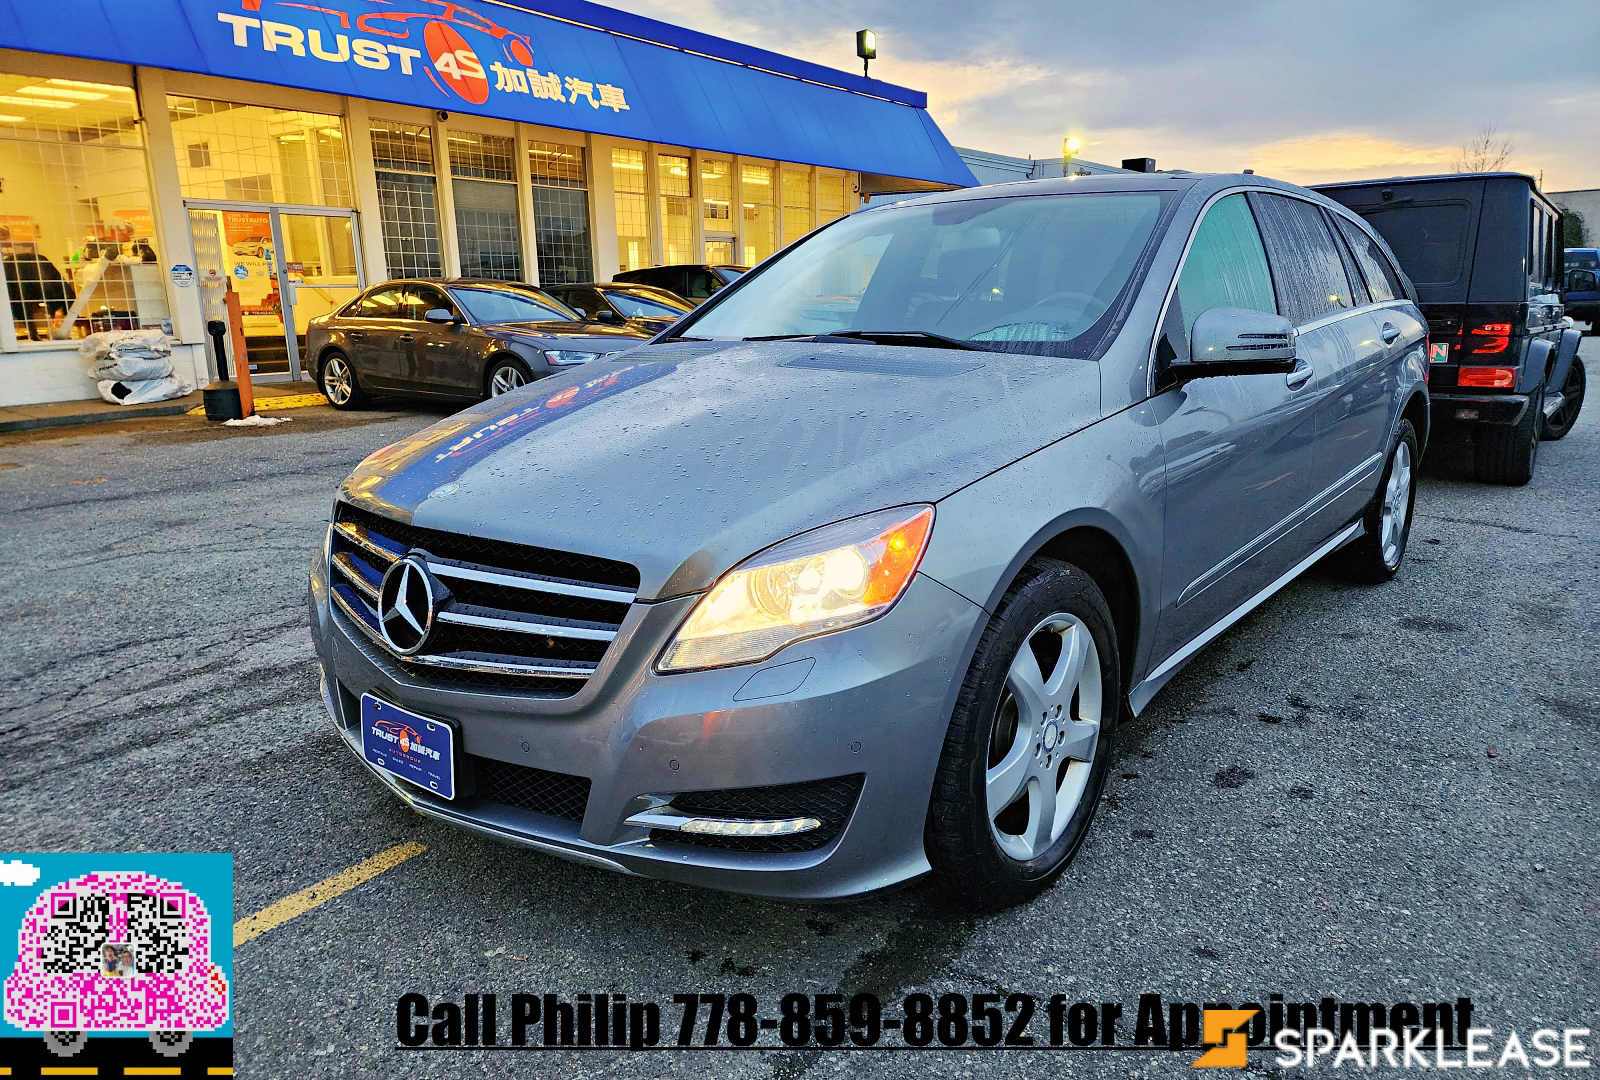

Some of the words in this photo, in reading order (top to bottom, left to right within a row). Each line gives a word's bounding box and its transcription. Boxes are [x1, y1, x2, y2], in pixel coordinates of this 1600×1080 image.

[217, 12, 422, 76] TRUST
[433, 49, 488, 80] 4S
[489, 61, 631, 112] 加誠汽車
[371, 726, 400, 745] TRUST
